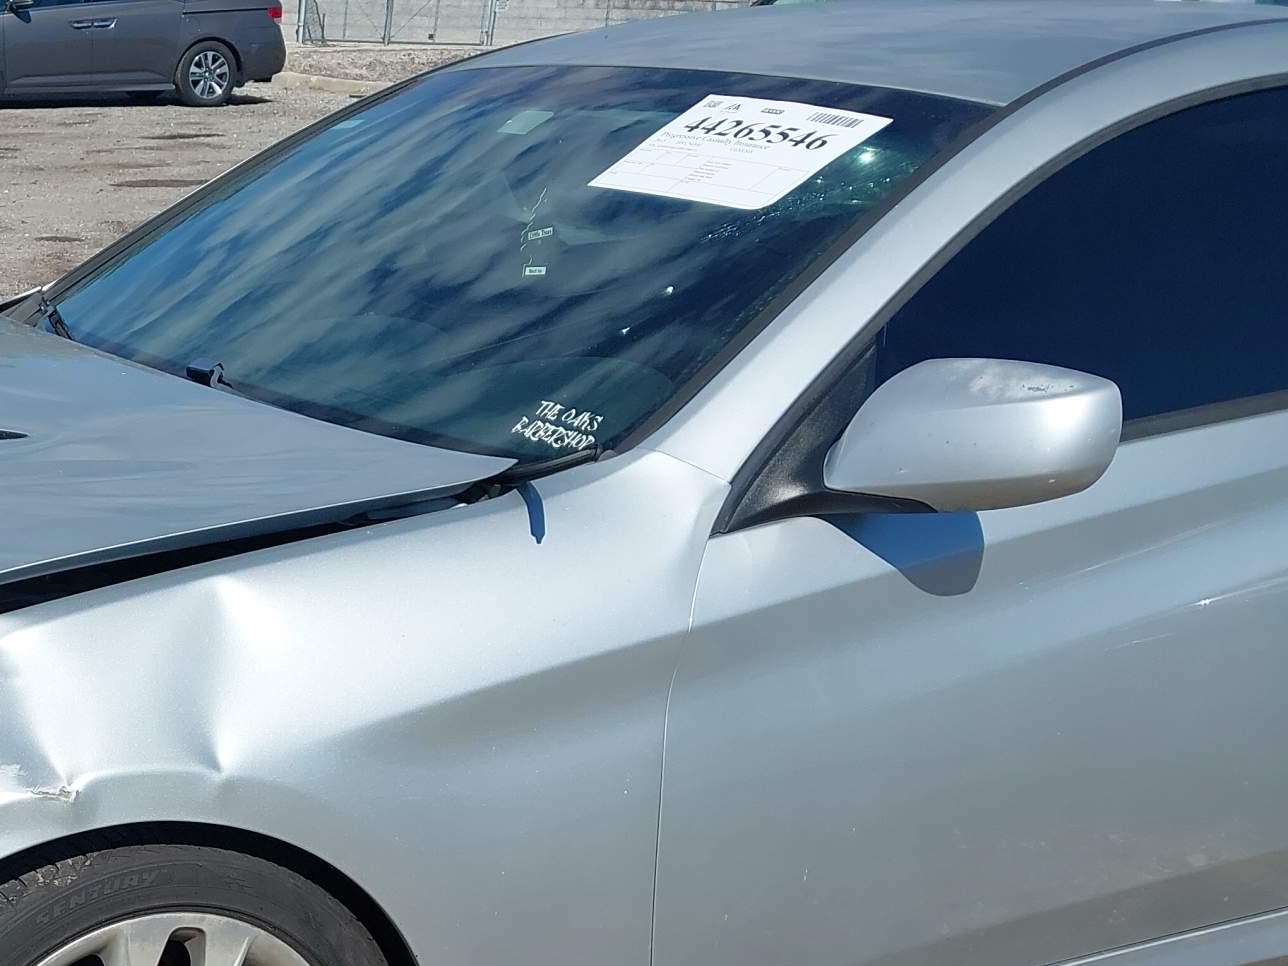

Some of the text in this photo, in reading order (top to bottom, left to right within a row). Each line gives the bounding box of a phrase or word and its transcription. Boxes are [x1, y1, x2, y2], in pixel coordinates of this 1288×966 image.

[684, 116, 839, 150] 44265546
[511, 416, 595, 450] BARBERSHOP
[535, 401, 604, 431] THE OAKS
